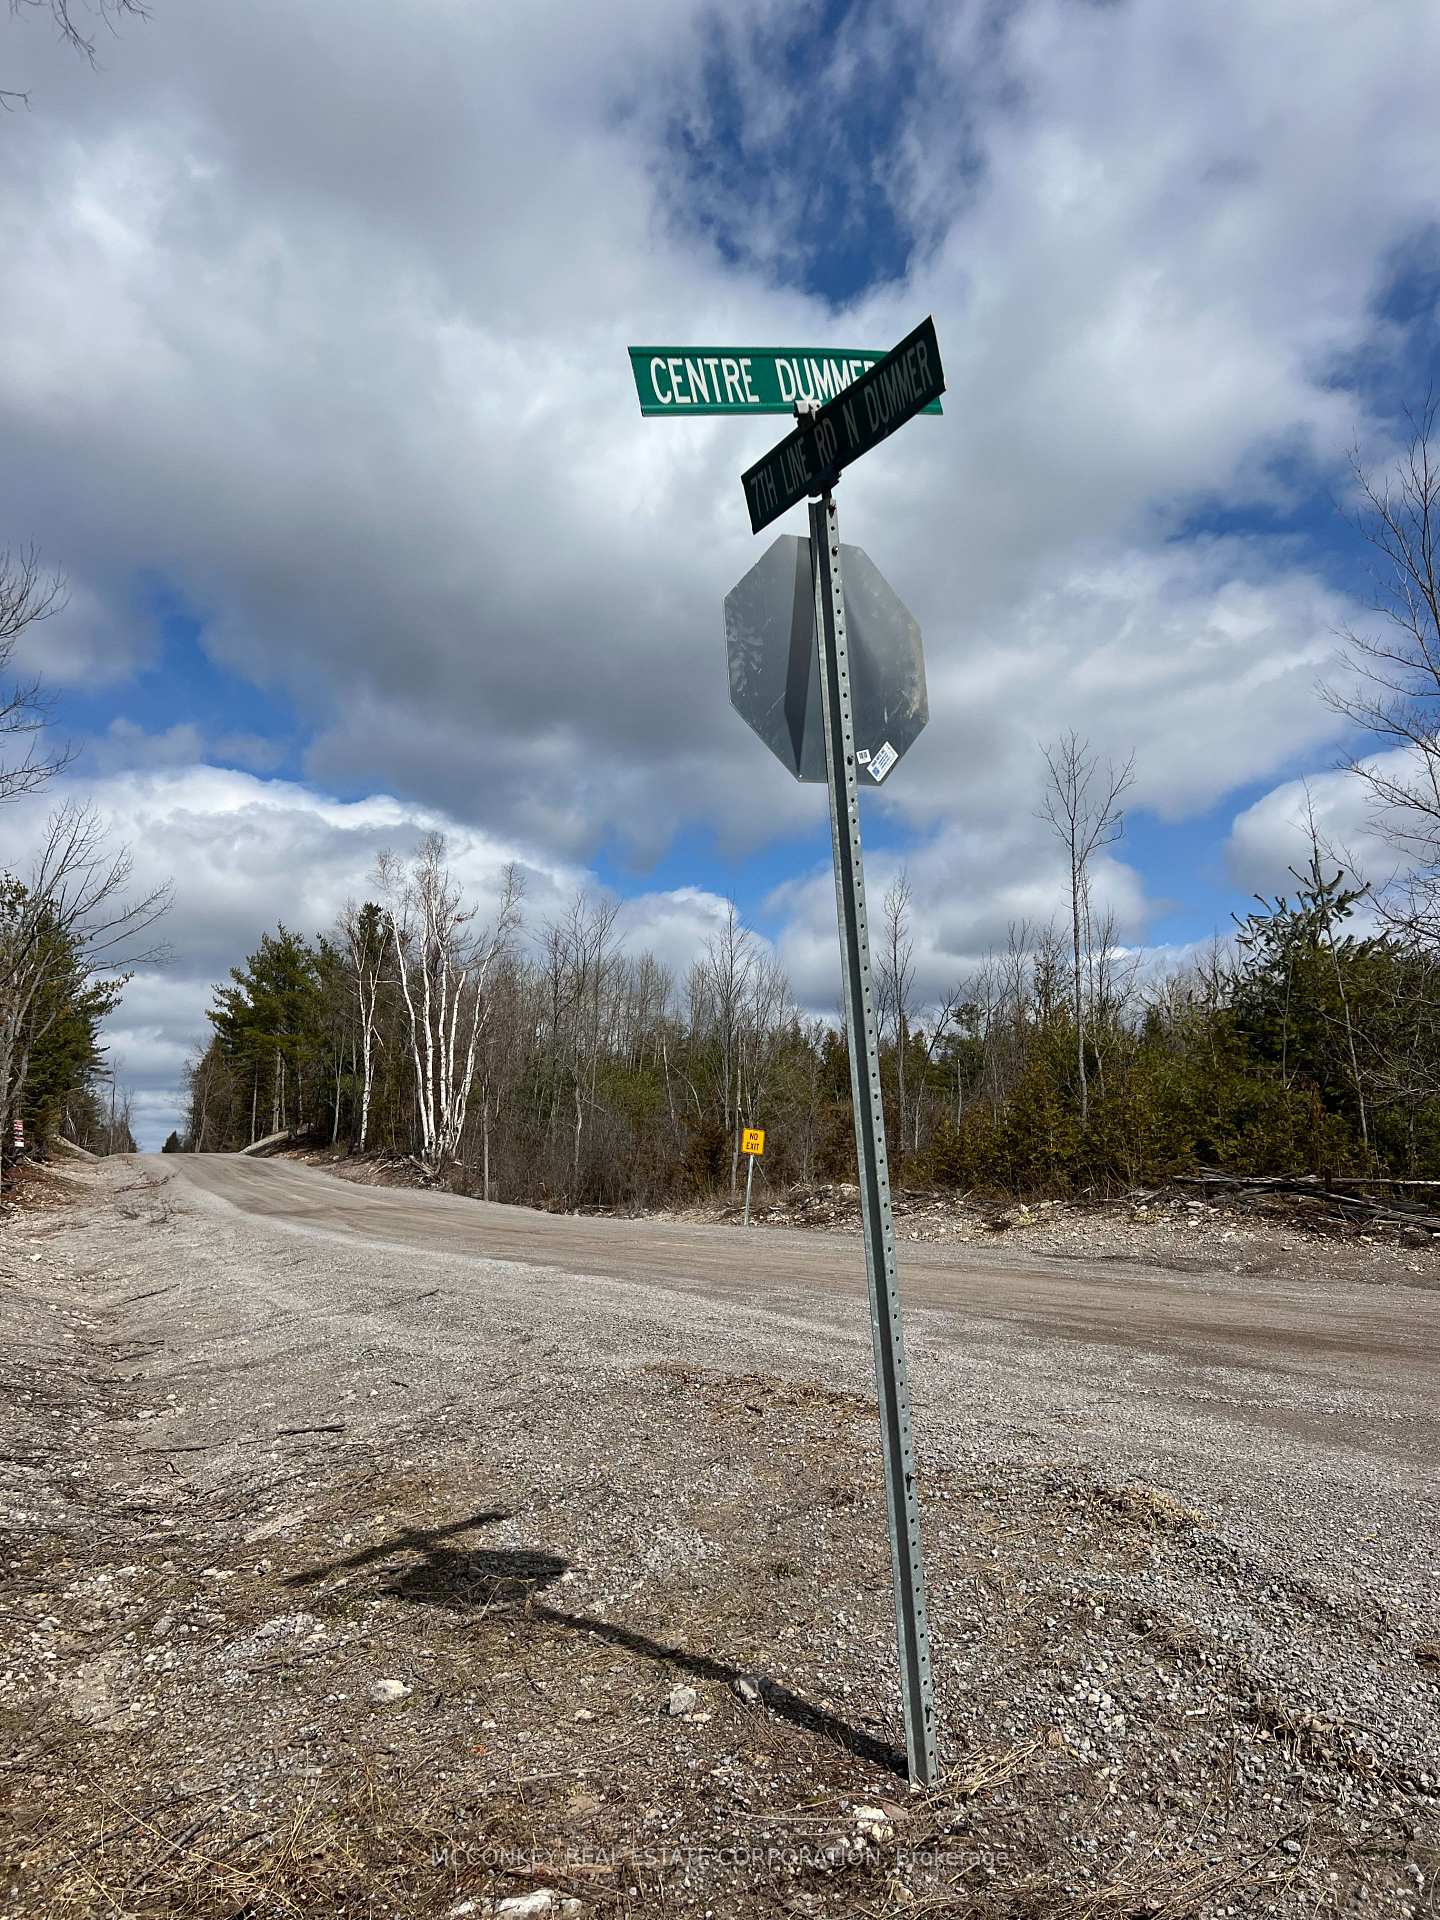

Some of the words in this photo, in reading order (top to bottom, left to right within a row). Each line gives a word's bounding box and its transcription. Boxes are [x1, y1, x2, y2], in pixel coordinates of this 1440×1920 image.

[650, 357, 760, 404] CENTRE
[775, 358, 877, 403] DUMME
[750, 467, 778, 518] 7TH
[779, 439, 812, 495] LINE
[814, 417, 838, 468] RD
[842, 399, 860, 448] N
[864, 339, 934, 432] DUMMER
[746, 1141, 760, 1150] EXIT
[749, 1132, 759, 1141] NO
